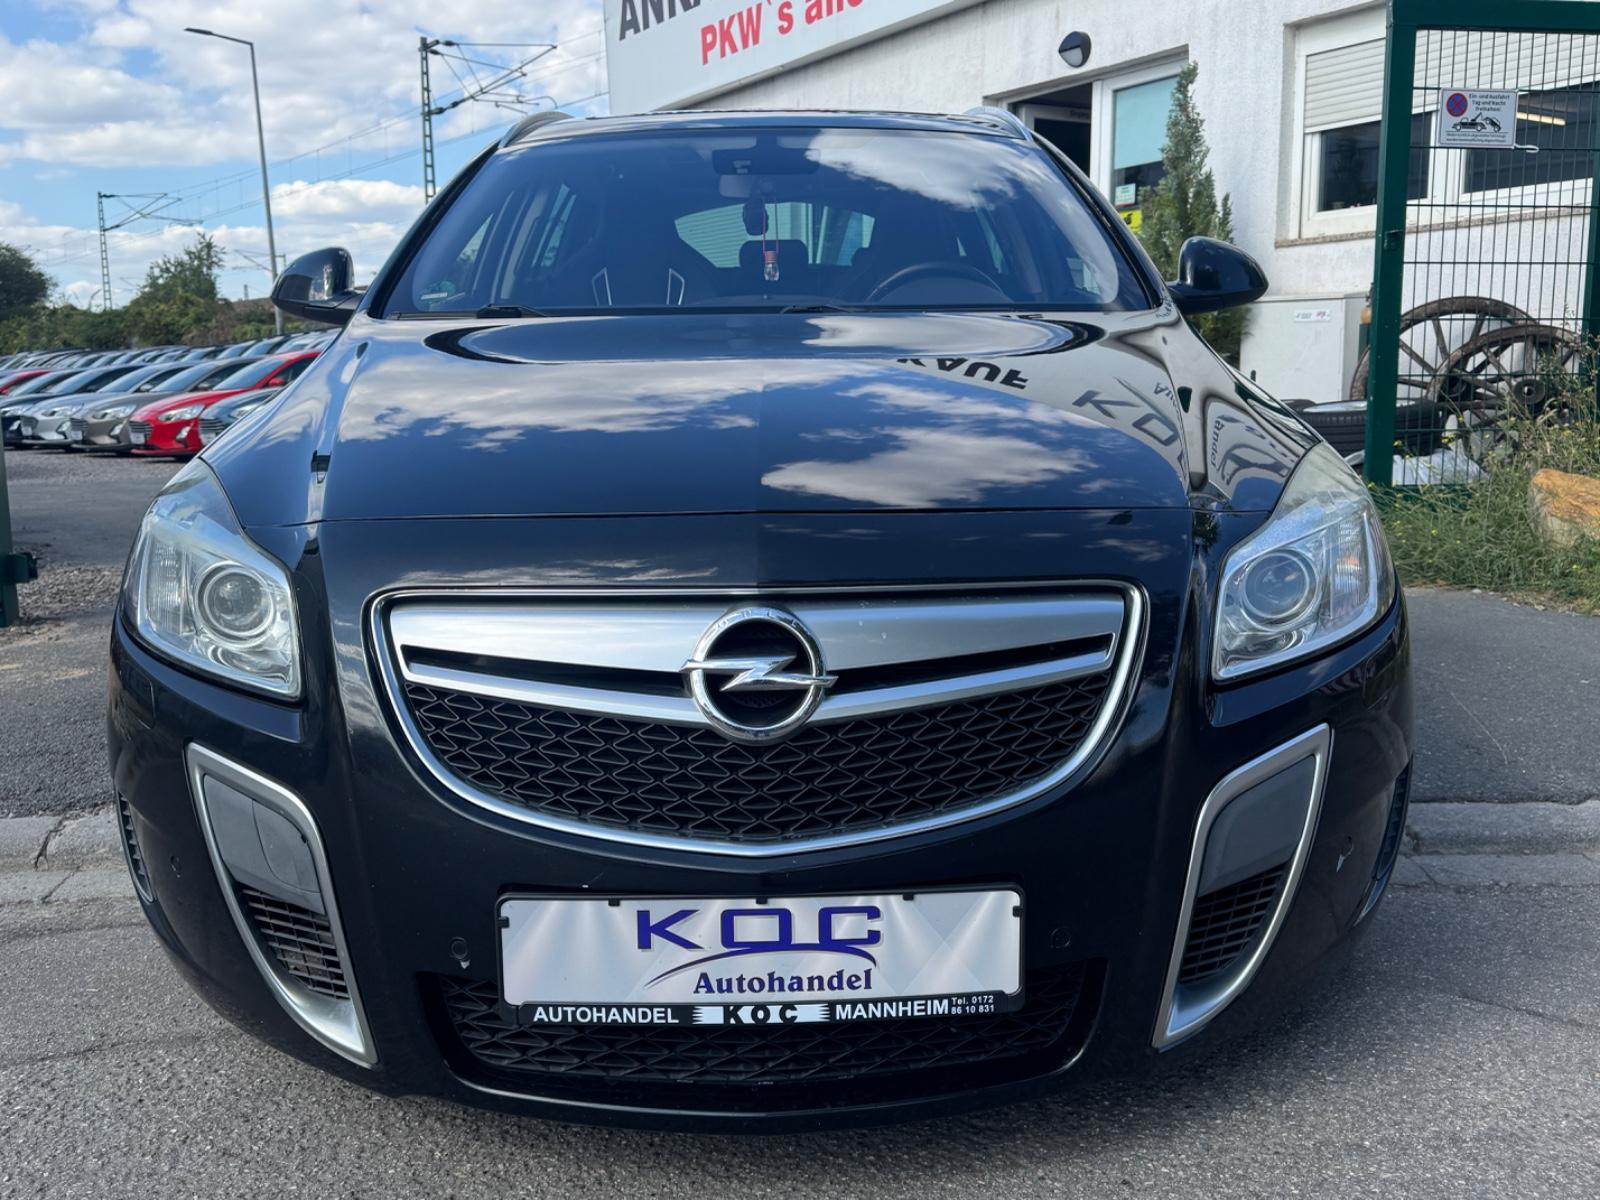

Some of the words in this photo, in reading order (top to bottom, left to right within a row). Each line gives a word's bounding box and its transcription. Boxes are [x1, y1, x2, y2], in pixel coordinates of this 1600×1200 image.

[636, 905, 882, 950] KOC
[692, 967, 874, 995] Autohandel
[532, 1005, 680, 1024] AUTOHANDEL
[835, 998, 949, 1021] MANNHEIM
[950, 1006, 962, 1015] 86
[965, 1005, 976, 1014] 10
[978, 1004, 995, 1013] 831
[951, 997, 968, 1005] Tel.
[971, 995, 994, 1004] 0172
